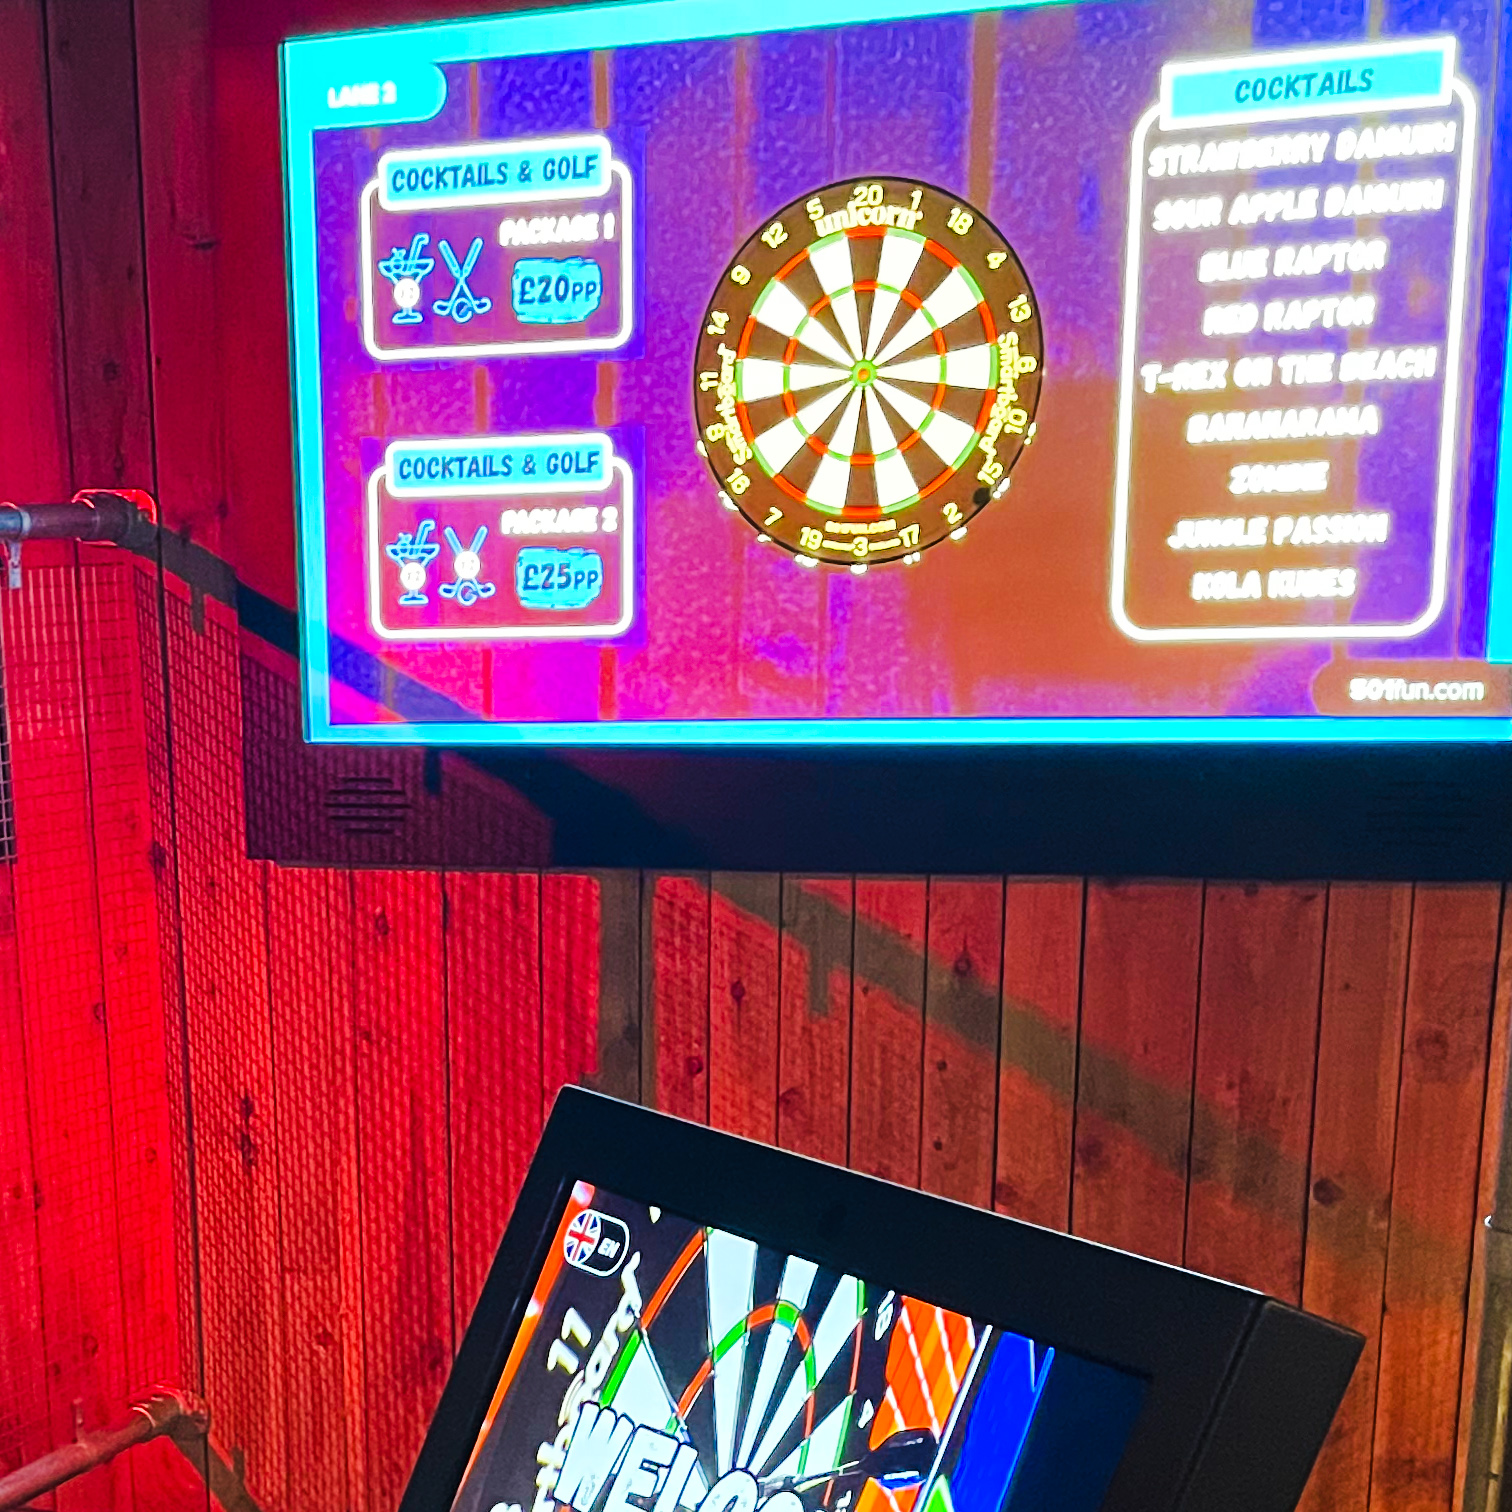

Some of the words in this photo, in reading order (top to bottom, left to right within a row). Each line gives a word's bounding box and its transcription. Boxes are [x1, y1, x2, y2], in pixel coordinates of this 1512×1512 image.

[1235, 68, 1374, 104] COCKTAILS
[392, 162, 508, 193] COCKTAILS
[517, 160, 532, 183] &
[543, 154, 599, 181] GOLF
[805, 196, 824, 221] 5
[850, 184, 884, 209] 20
[909, 189, 923, 211] 1
[1228, 187, 1320, 226] APPLE
[815, 203, 923, 237] unicorn
[946, 207, 974, 235] 18
[760, 221, 789, 249] 12
[986, 251, 1008, 271] 4
[1273, 240, 1386, 276] RAPTOR
[1263, 295, 1376, 331] RAPTOR
[1141, 359, 1229, 393] T-REX
[1233, 357, 1273, 388] ON
[1278, 353, 1335, 384] THE
[1338, 346, 1437, 382] BEACH
[1003, 408, 1028, 434] 10
[399, 455, 512, 479] COCKTAILS
[522, 453, 536, 475] &
[546, 450, 600, 475] GOLF
[761, 506, 784, 526] 7
[942, 502, 963, 525] 2
[800, 526, 824, 551] 19
[852, 536, 869, 557] 3
[898, 522, 921, 548] 17
[598, 1238, 620, 1259] EN
